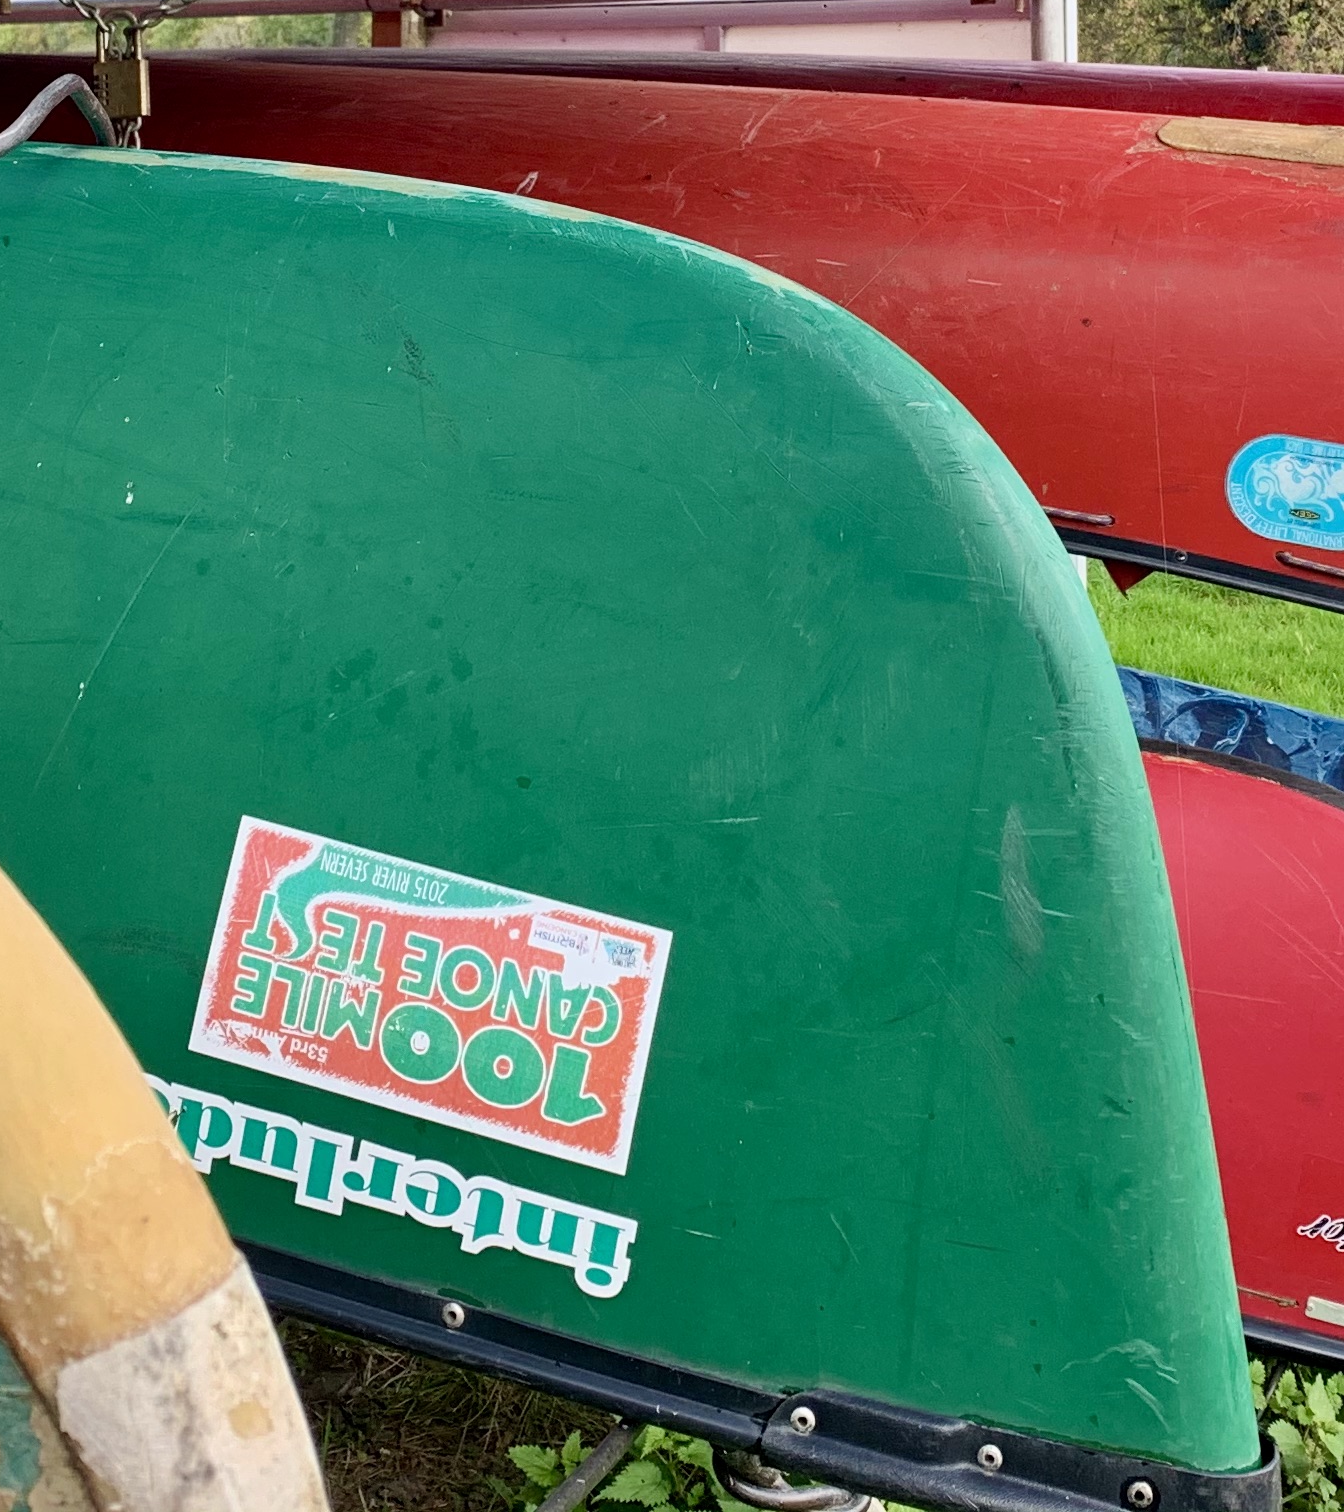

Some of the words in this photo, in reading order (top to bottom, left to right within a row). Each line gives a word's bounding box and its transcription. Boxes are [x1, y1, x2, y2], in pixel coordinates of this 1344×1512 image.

[318, 849, 369, 883] SEVERN
[373, 864, 411, 895] RIVER
[412, 875, 449, 906] 2015
[238, 891, 387, 987] TEST
[230, 953, 381, 1051] MILE
[396, 931, 623, 1047] CANOE
[289, 1037, 329, 1064] 53rd
[379, 1000, 606, 1128] 100
[142, 1076, 627, 1291] interlud
